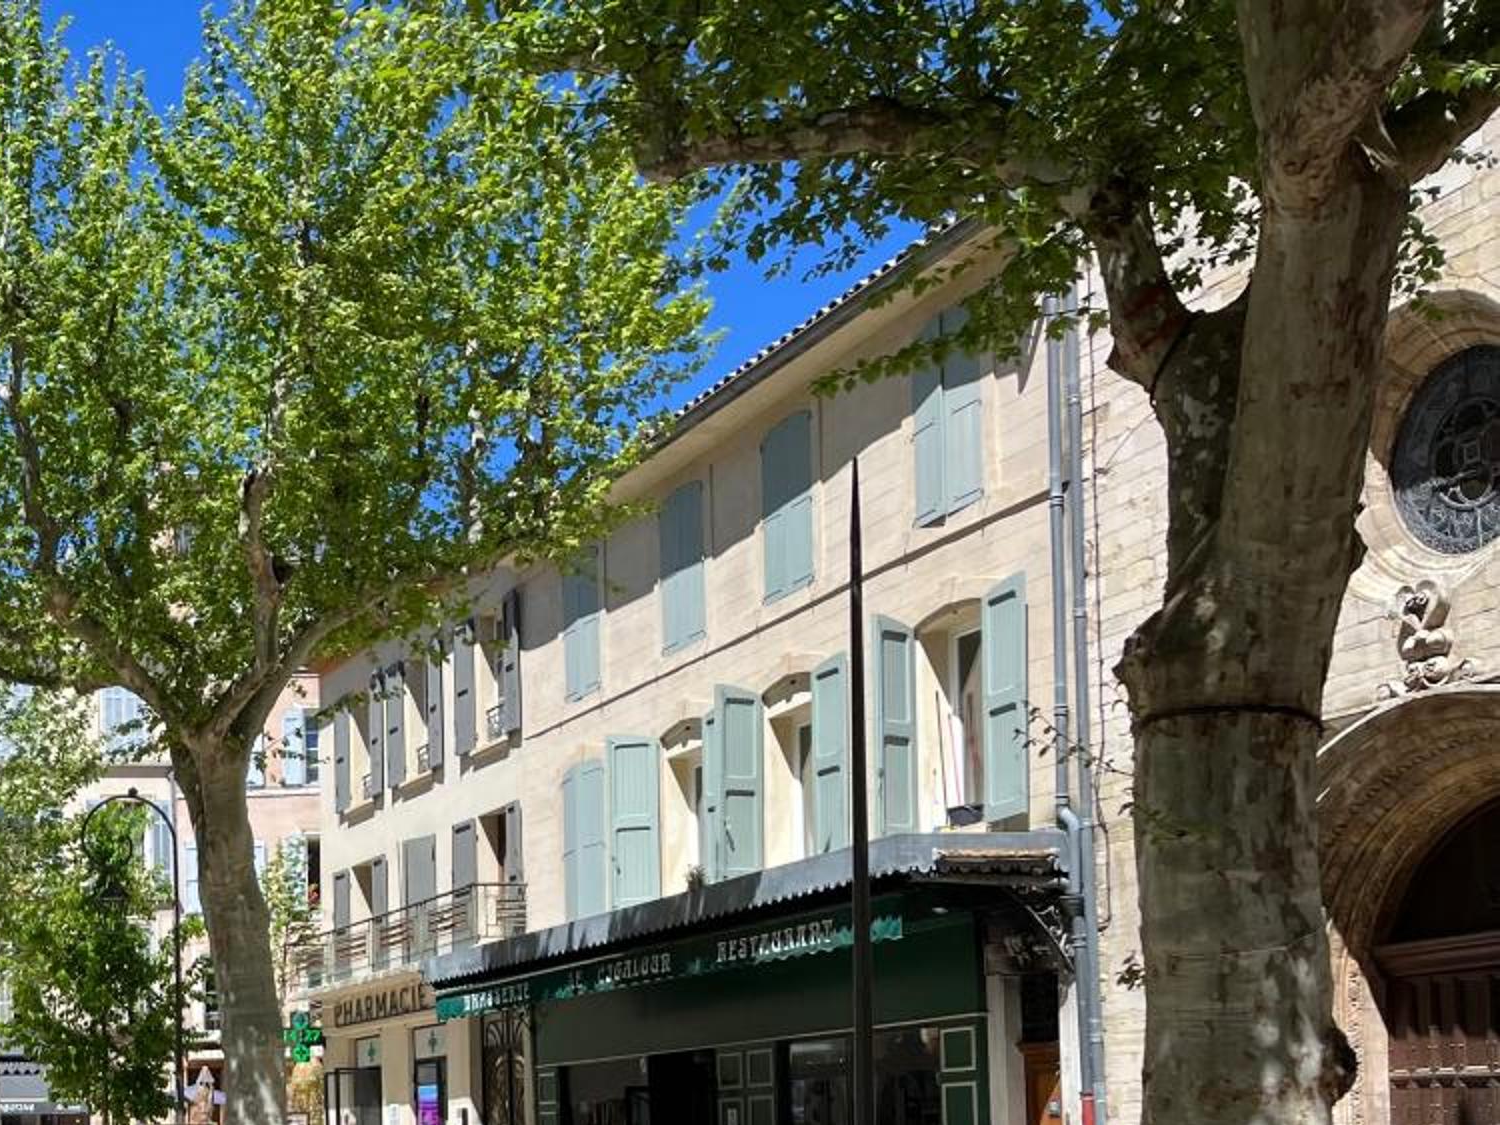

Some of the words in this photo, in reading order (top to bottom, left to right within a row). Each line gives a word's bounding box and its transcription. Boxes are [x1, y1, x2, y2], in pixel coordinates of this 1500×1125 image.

[463, 981, 530, 1011] BRASSERIE
[716, 918, 835, 963] RESTAURANT
[334, 983, 426, 1028] PHARMACIE
